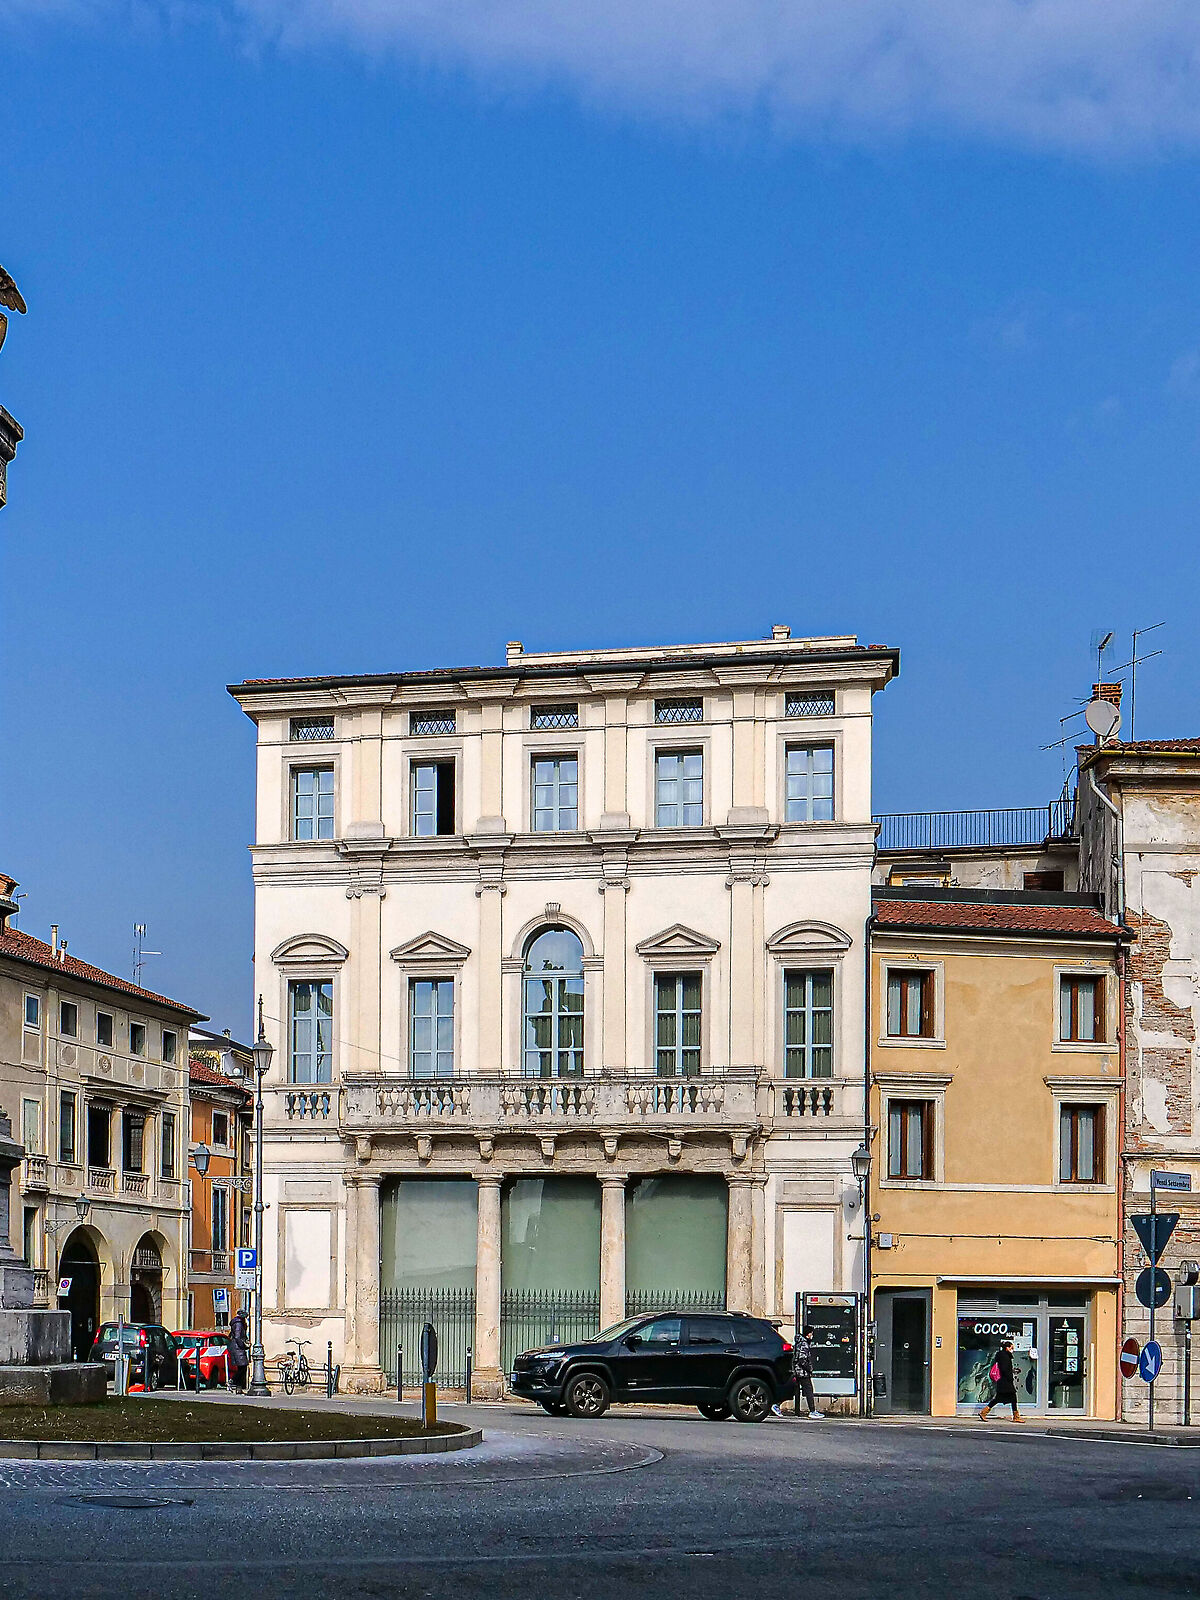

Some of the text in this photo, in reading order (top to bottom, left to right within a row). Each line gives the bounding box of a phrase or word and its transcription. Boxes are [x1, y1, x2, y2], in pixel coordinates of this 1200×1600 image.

[242, 1251, 253, 1266] P
[216, 1290, 223, 1300] P
[974, 1323, 1008, 1335] COCO
